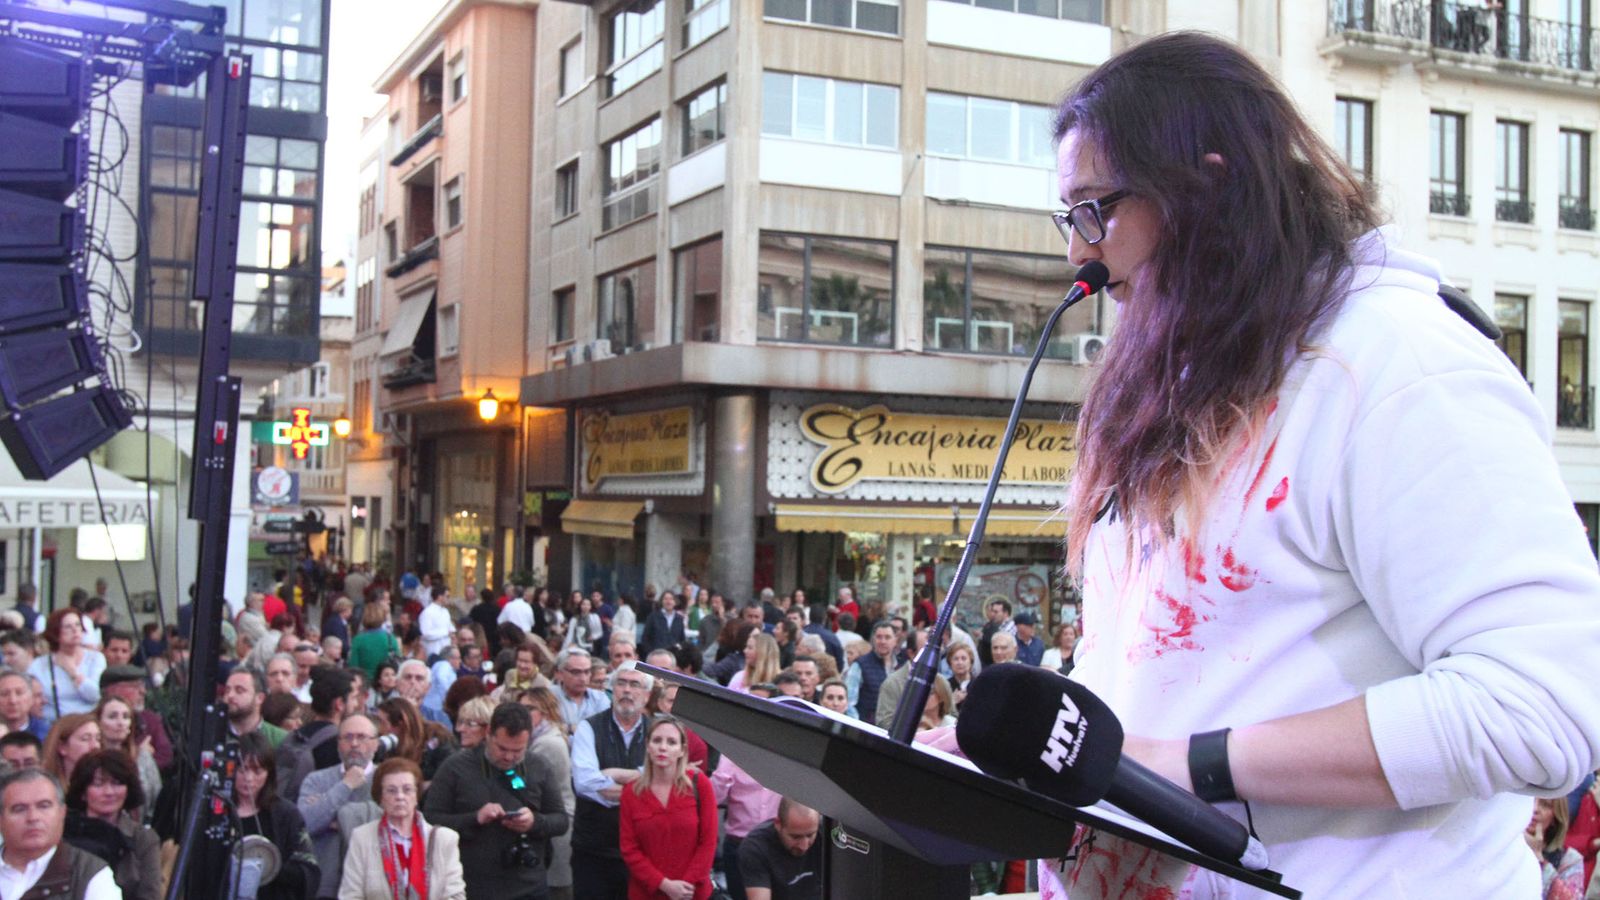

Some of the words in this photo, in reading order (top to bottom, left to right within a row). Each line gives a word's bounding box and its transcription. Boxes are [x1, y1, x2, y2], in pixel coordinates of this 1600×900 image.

[806, 410, 998, 487] Encajeria
[1007, 422, 1078, 452] Plaz
[888, 461, 937, 478] LANAS
[952, 463, 1008, 480] MEDIS
[1040, 692, 1081, 774] HTV
